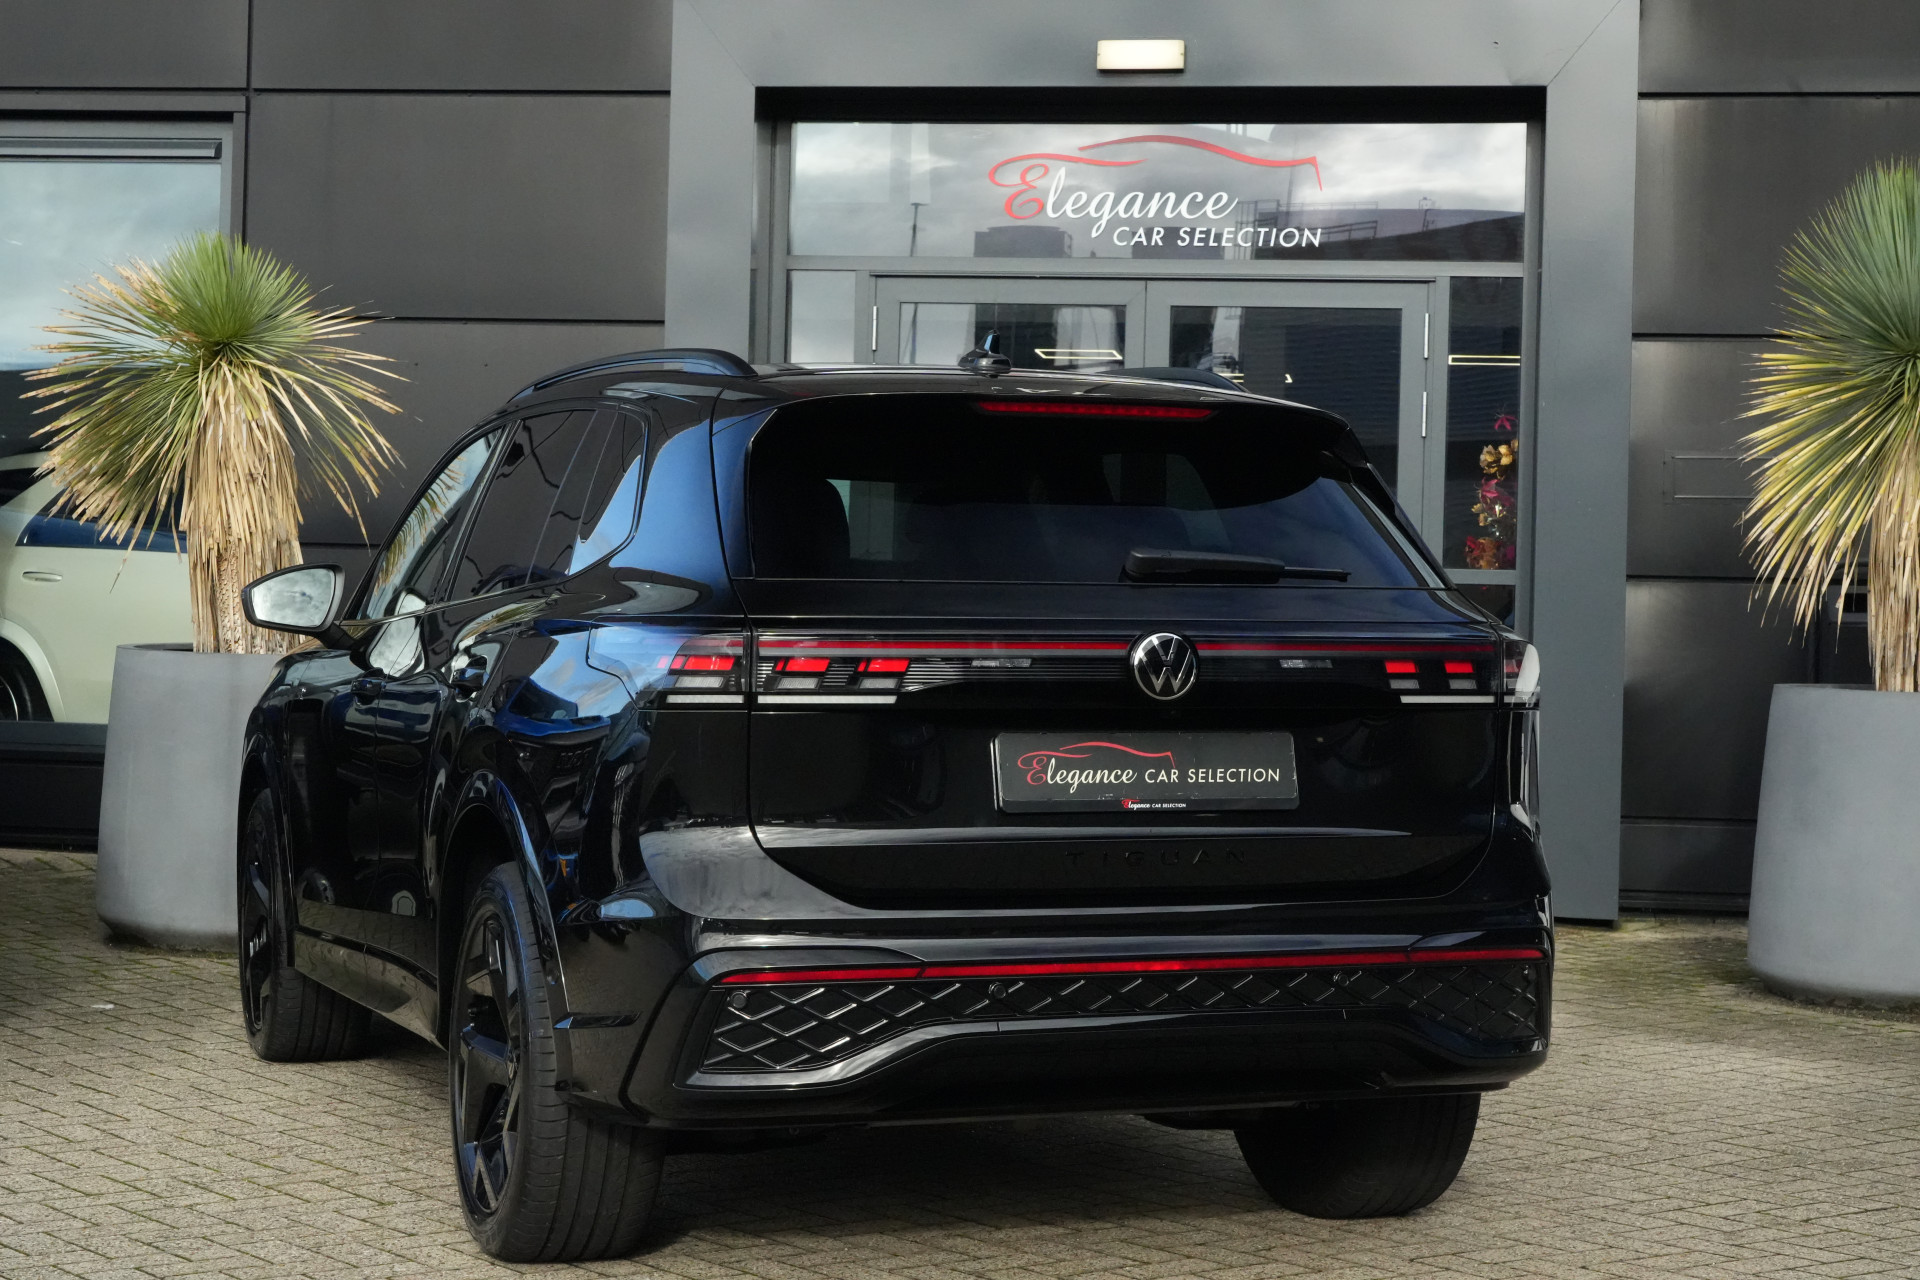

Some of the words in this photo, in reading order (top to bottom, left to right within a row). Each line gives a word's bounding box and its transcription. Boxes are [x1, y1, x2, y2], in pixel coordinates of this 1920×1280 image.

[988, 155, 1239, 238] Elegance
[1112, 226, 1165, 247] CAR
[1176, 226, 1323, 248] SELECTION
[1018, 752, 1137, 793] Elegance
[1145, 769, 1179, 783] CAR
[1187, 768, 1280, 783] SELECTION
[1121, 799, 1151, 811] Elegance
[1065, 849, 1246, 867] TIGUAN
